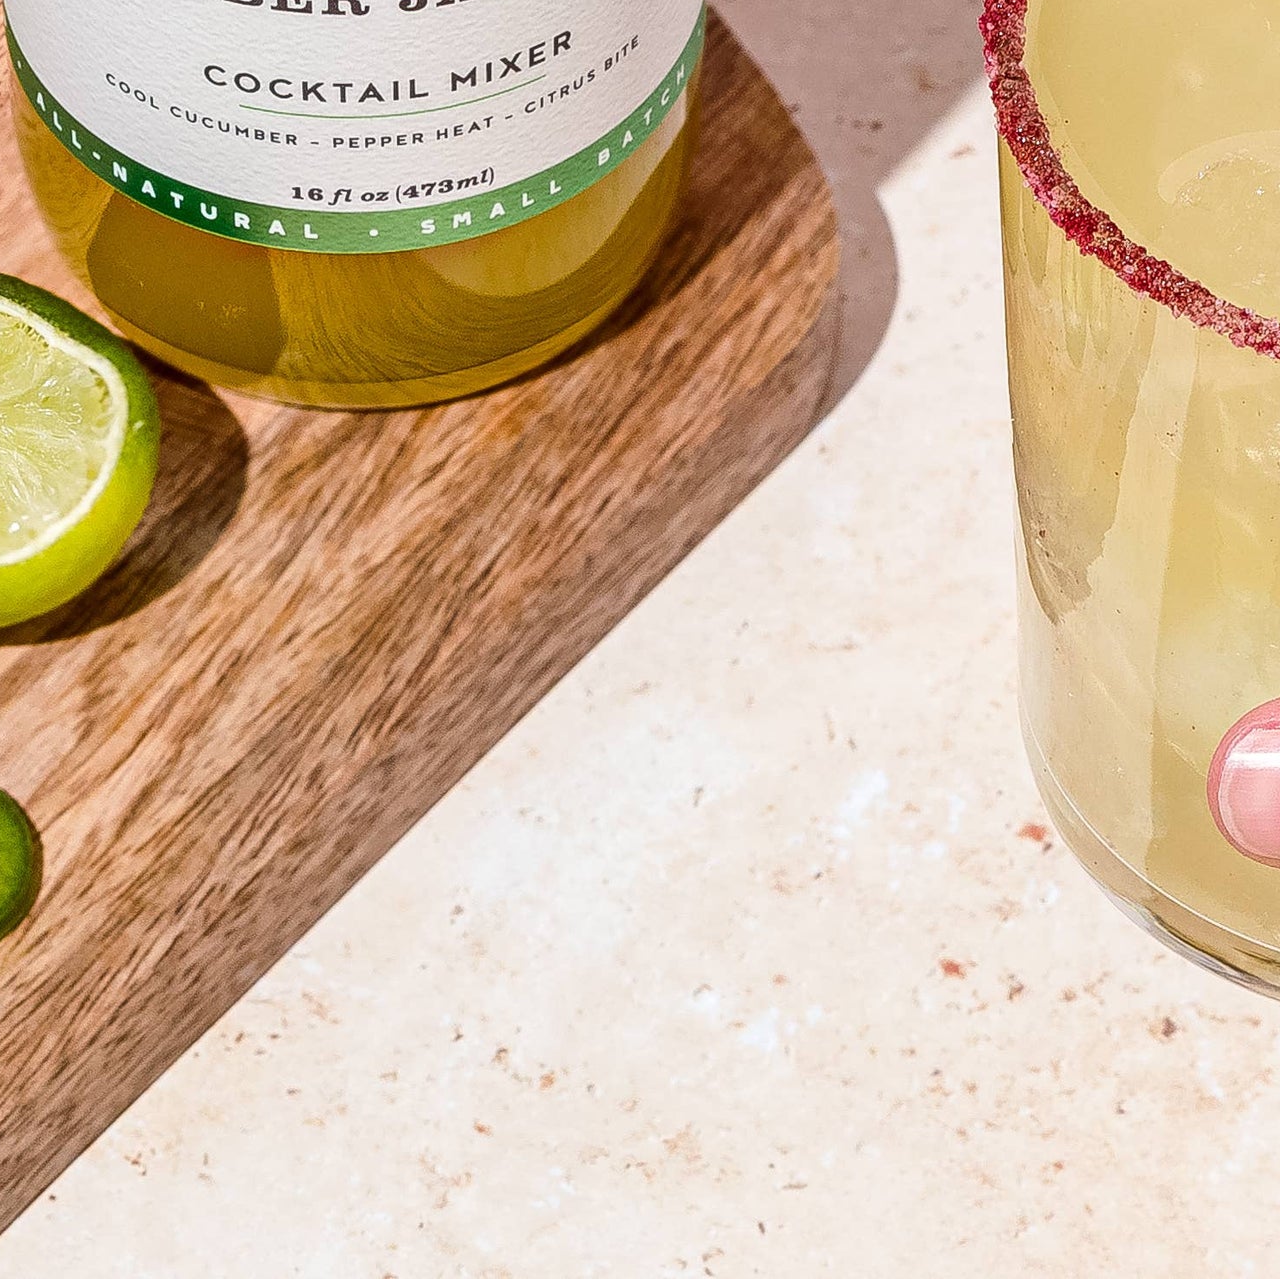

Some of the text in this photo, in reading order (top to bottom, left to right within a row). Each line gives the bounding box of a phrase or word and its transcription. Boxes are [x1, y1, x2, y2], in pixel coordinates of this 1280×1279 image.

[105, 72, 160, 110] COOL
[170, 105, 298, 146] CUCUMBER
[332, 133, 424, 149] PEPPER
[436, 116, 494, 141] HEAT
[523, 69, 596, 114] CITRUS
[603, 35, 640, 71] BITE
[203, 30, 572, 104] COCKTAIL MIXER
[291, 166, 495, 206] 16 fl oz (473ml)
[420, 179, 563, 235] SMALL
[597, 63, 686, 167] BATCH
